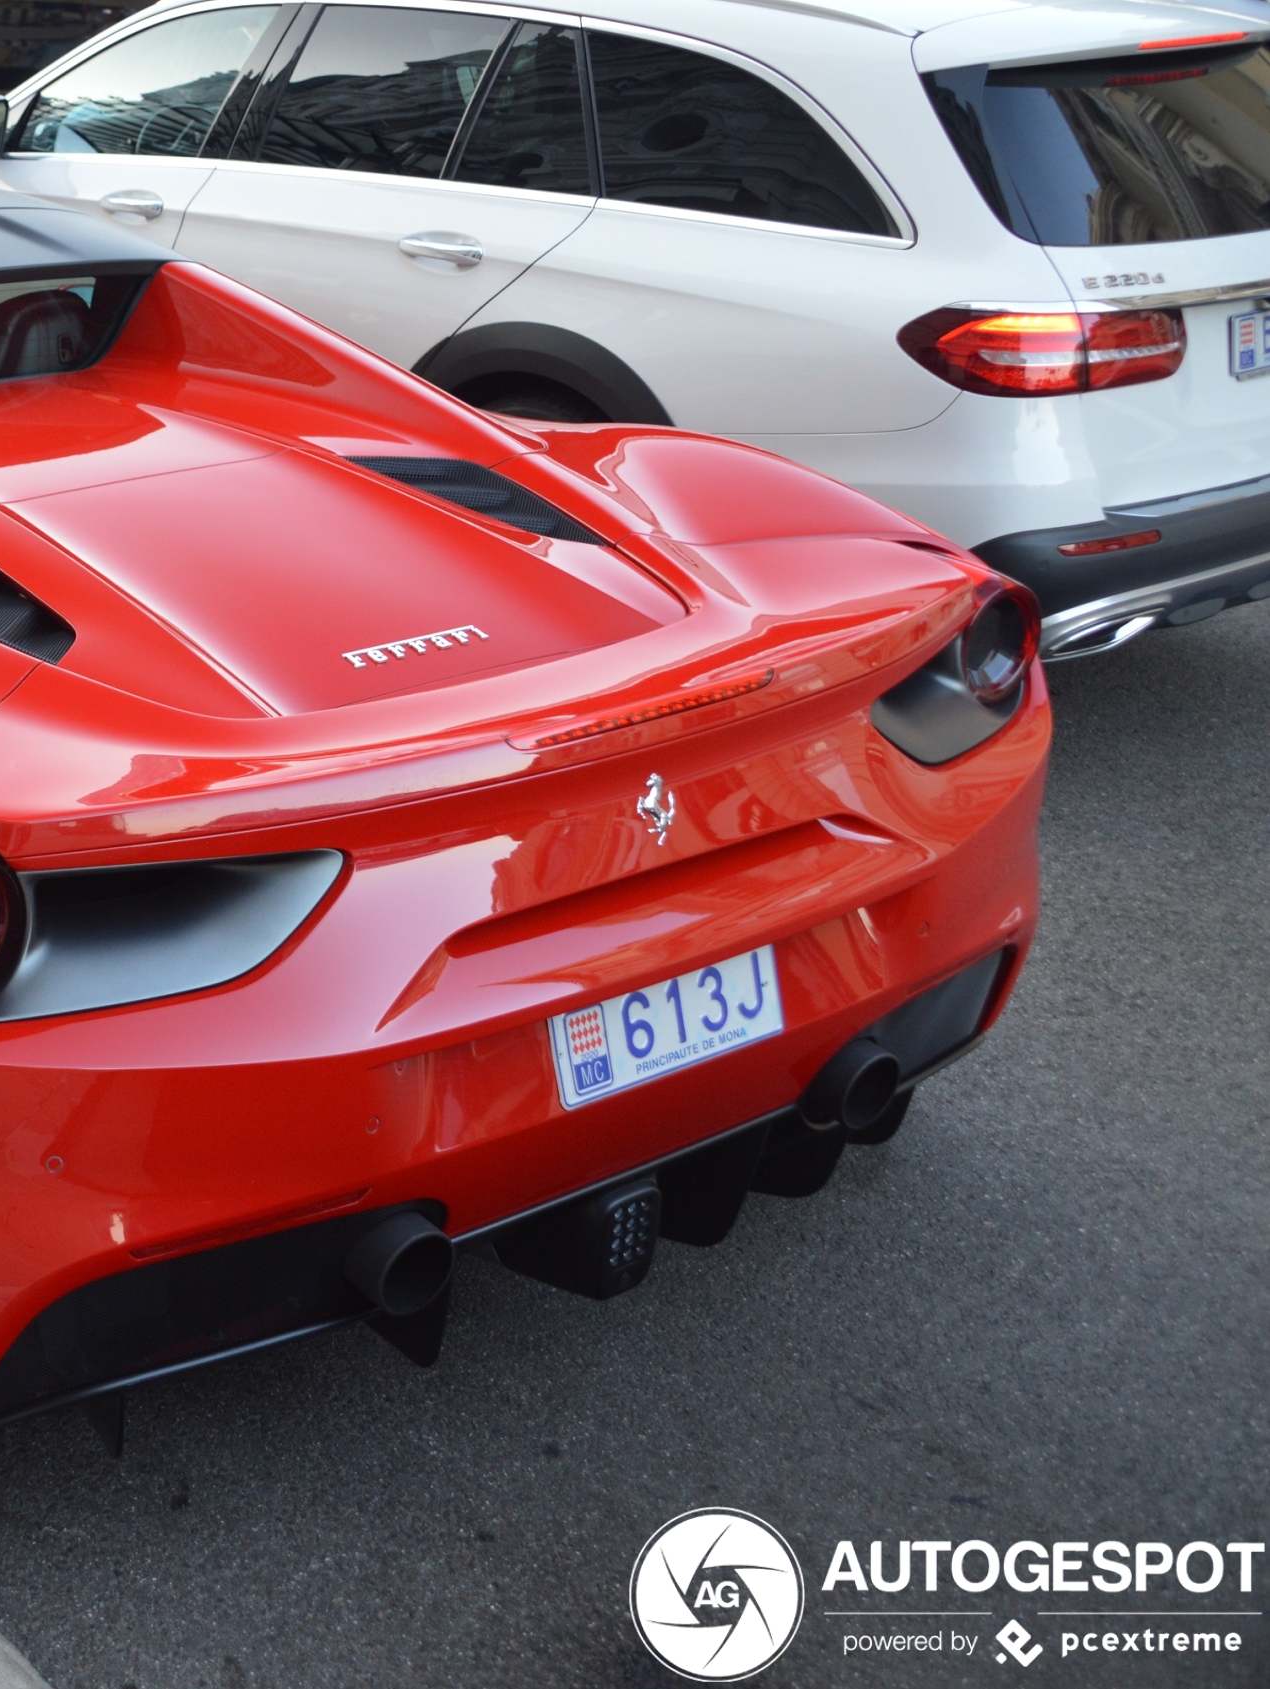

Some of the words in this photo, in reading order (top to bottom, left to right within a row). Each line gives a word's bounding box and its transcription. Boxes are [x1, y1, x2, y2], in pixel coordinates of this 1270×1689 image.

[1082, 276, 1100, 290] E
[1103, 272, 1150, 288] 220
[341, 624, 489, 669] Ferrari
[621, 951, 764, 1059] 613J
[580, 1048, 599, 1062] 2020
[635, 1043, 699, 1075] PRINCIPAUTE
[702, 1037, 716, 1051] DE
[718, 1026, 747, 1045] MONA
[580, 1060, 605, 1087] MC
